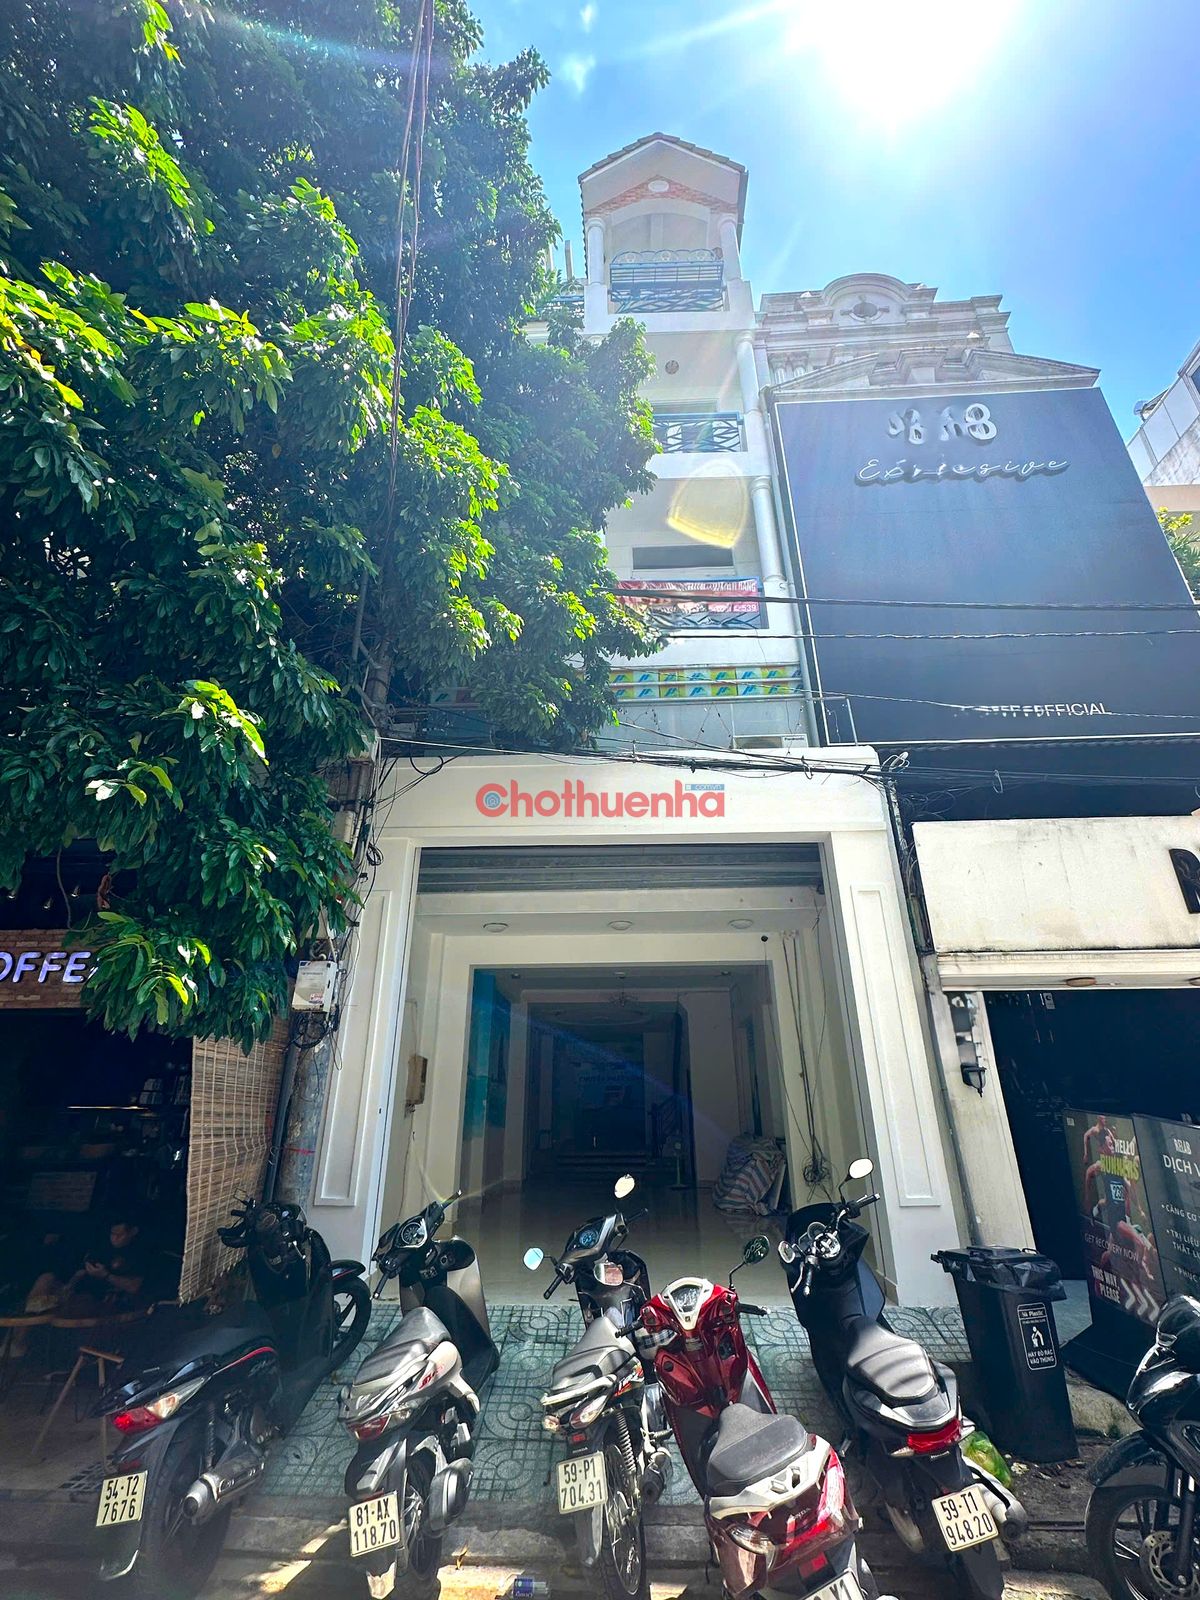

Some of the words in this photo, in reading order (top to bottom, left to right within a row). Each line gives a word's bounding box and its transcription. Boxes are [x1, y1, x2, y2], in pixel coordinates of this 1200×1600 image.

[1114, 1139, 1135, 1156] HELLO
[1162, 1154, 1192, 1175] DỊCH
[1099, 1283, 1121, 1304] PLEASE
[561, 1479, 602, 1509] 704.31
[102, 1498, 136, 1524] 7676
[354, 1519, 396, 1551] 118.70
[945, 1513, 993, 1546] 948.20
